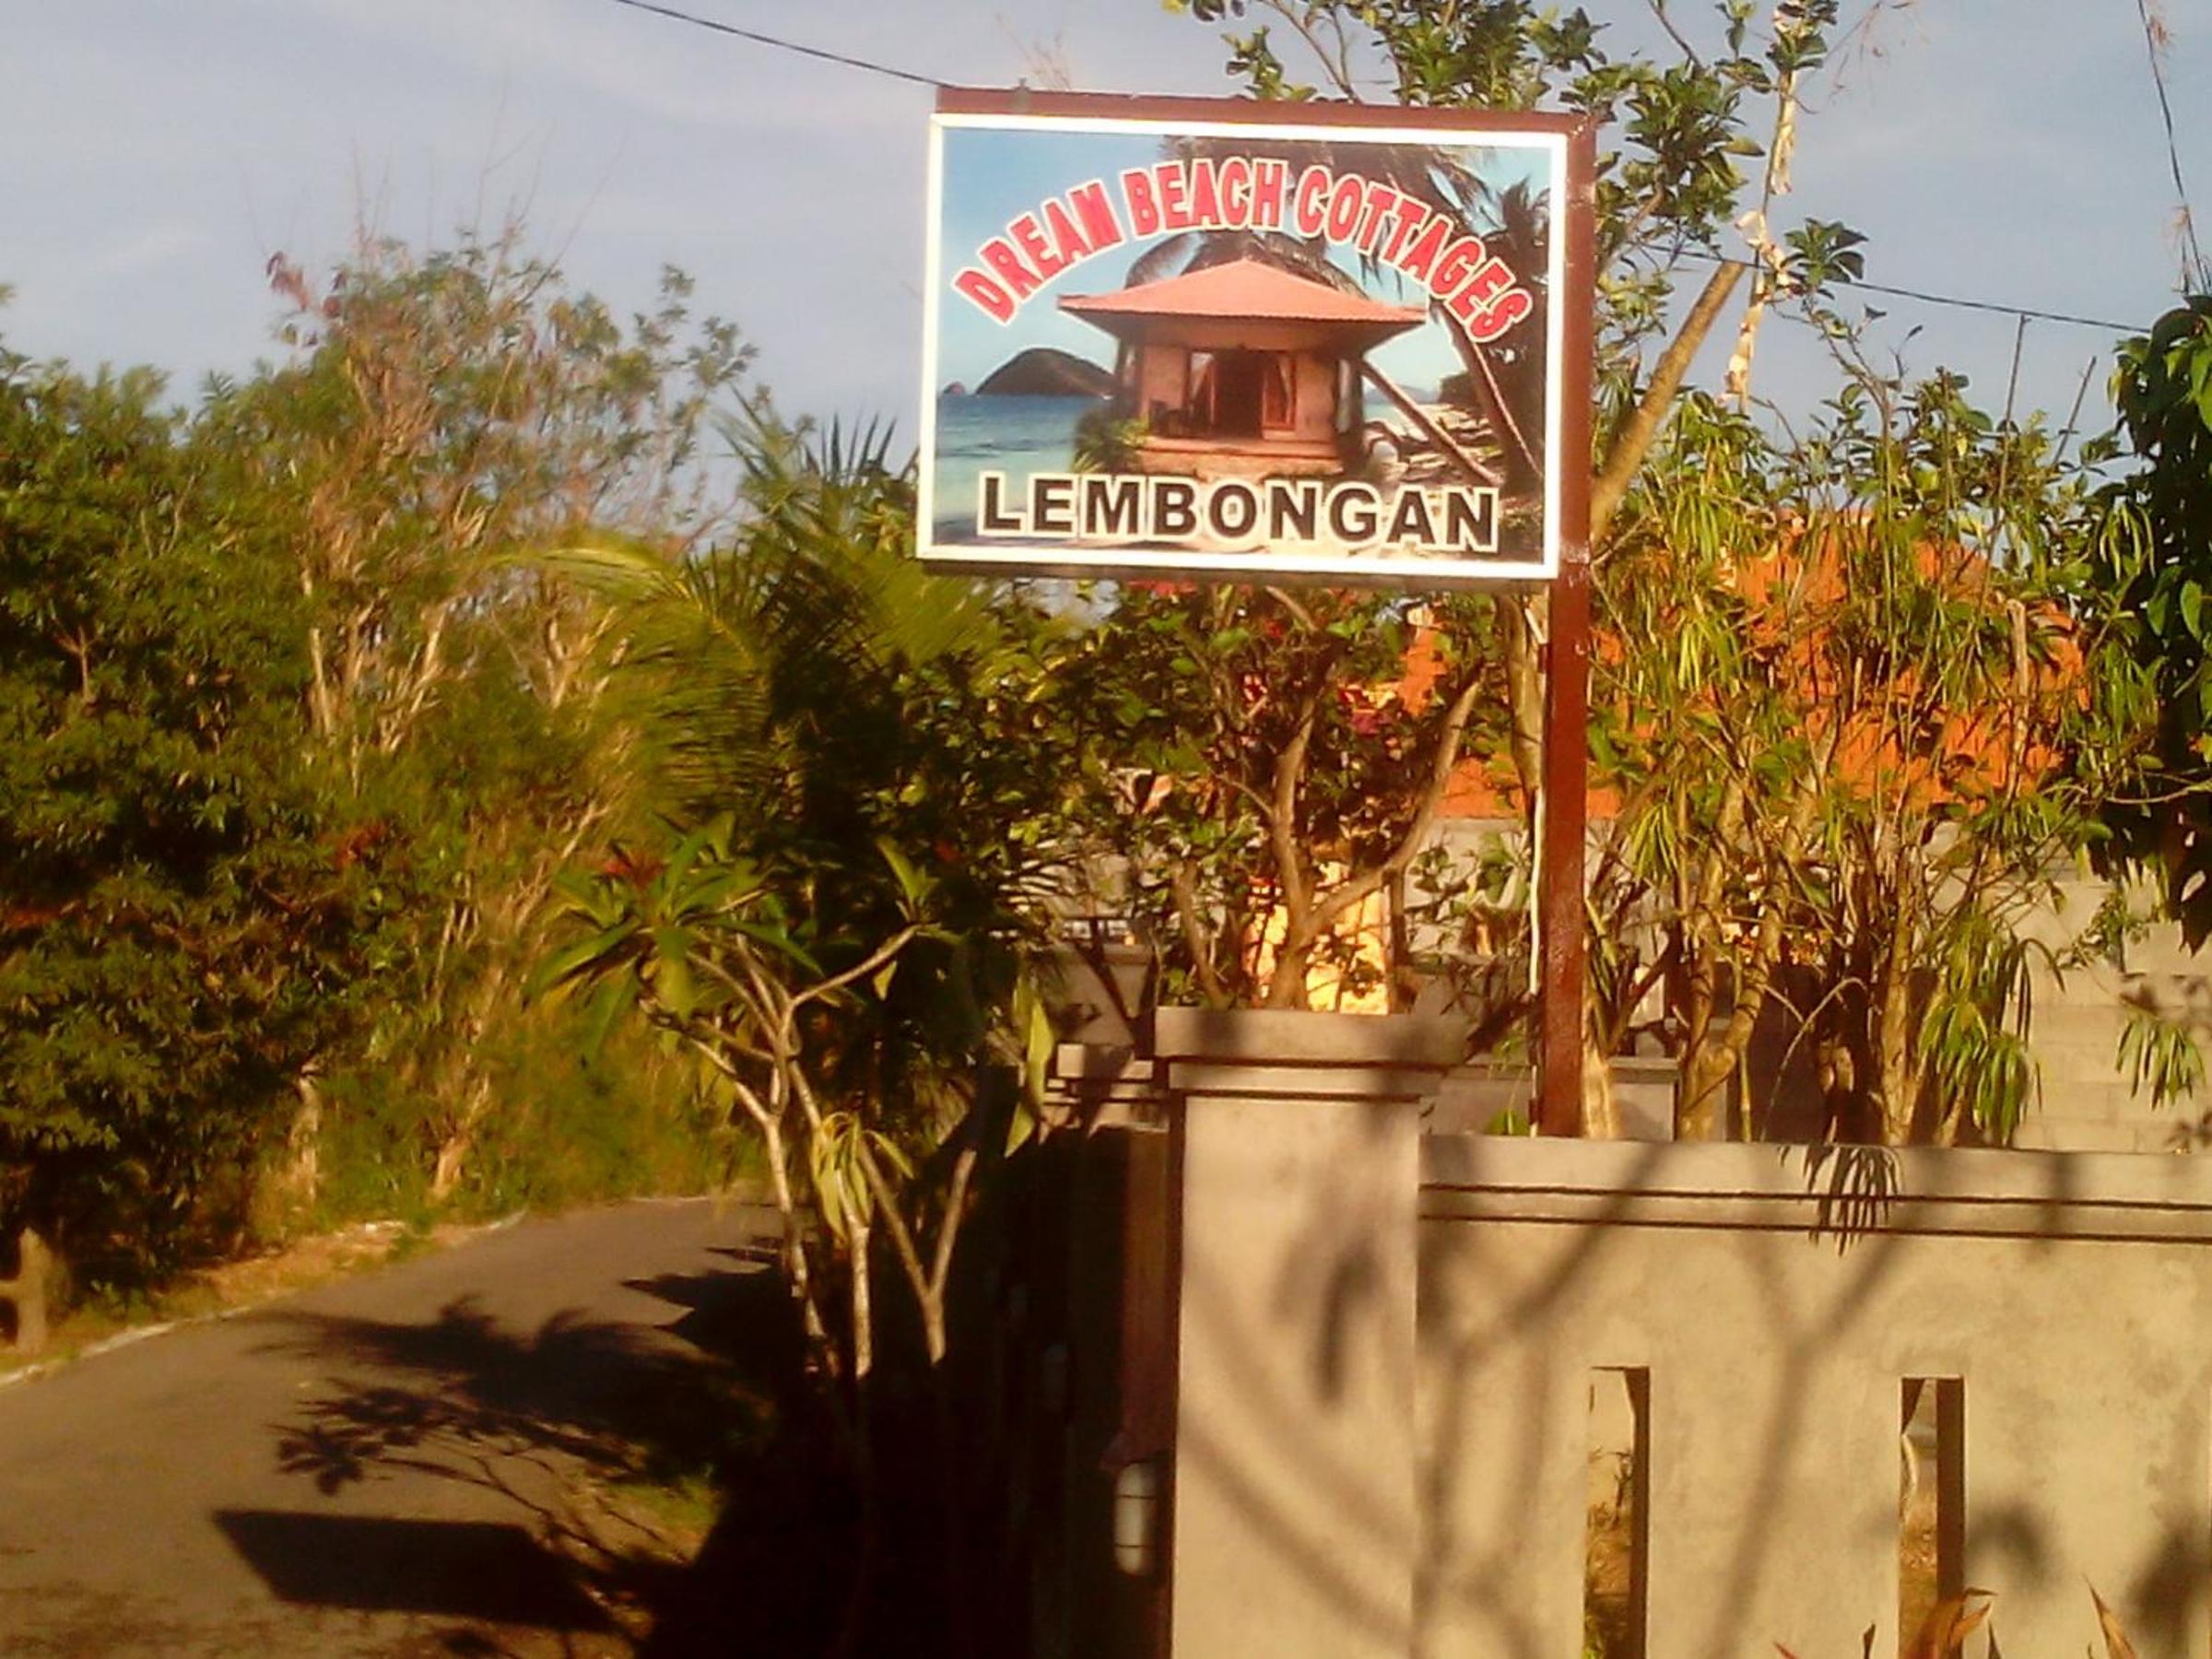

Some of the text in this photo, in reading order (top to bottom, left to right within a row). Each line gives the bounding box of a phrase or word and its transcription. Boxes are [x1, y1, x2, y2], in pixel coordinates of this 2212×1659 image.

[952, 157, 1533, 342] DREAM BEACH COTTAGES
[978, 471, 1499, 552] LEMBONGAN
